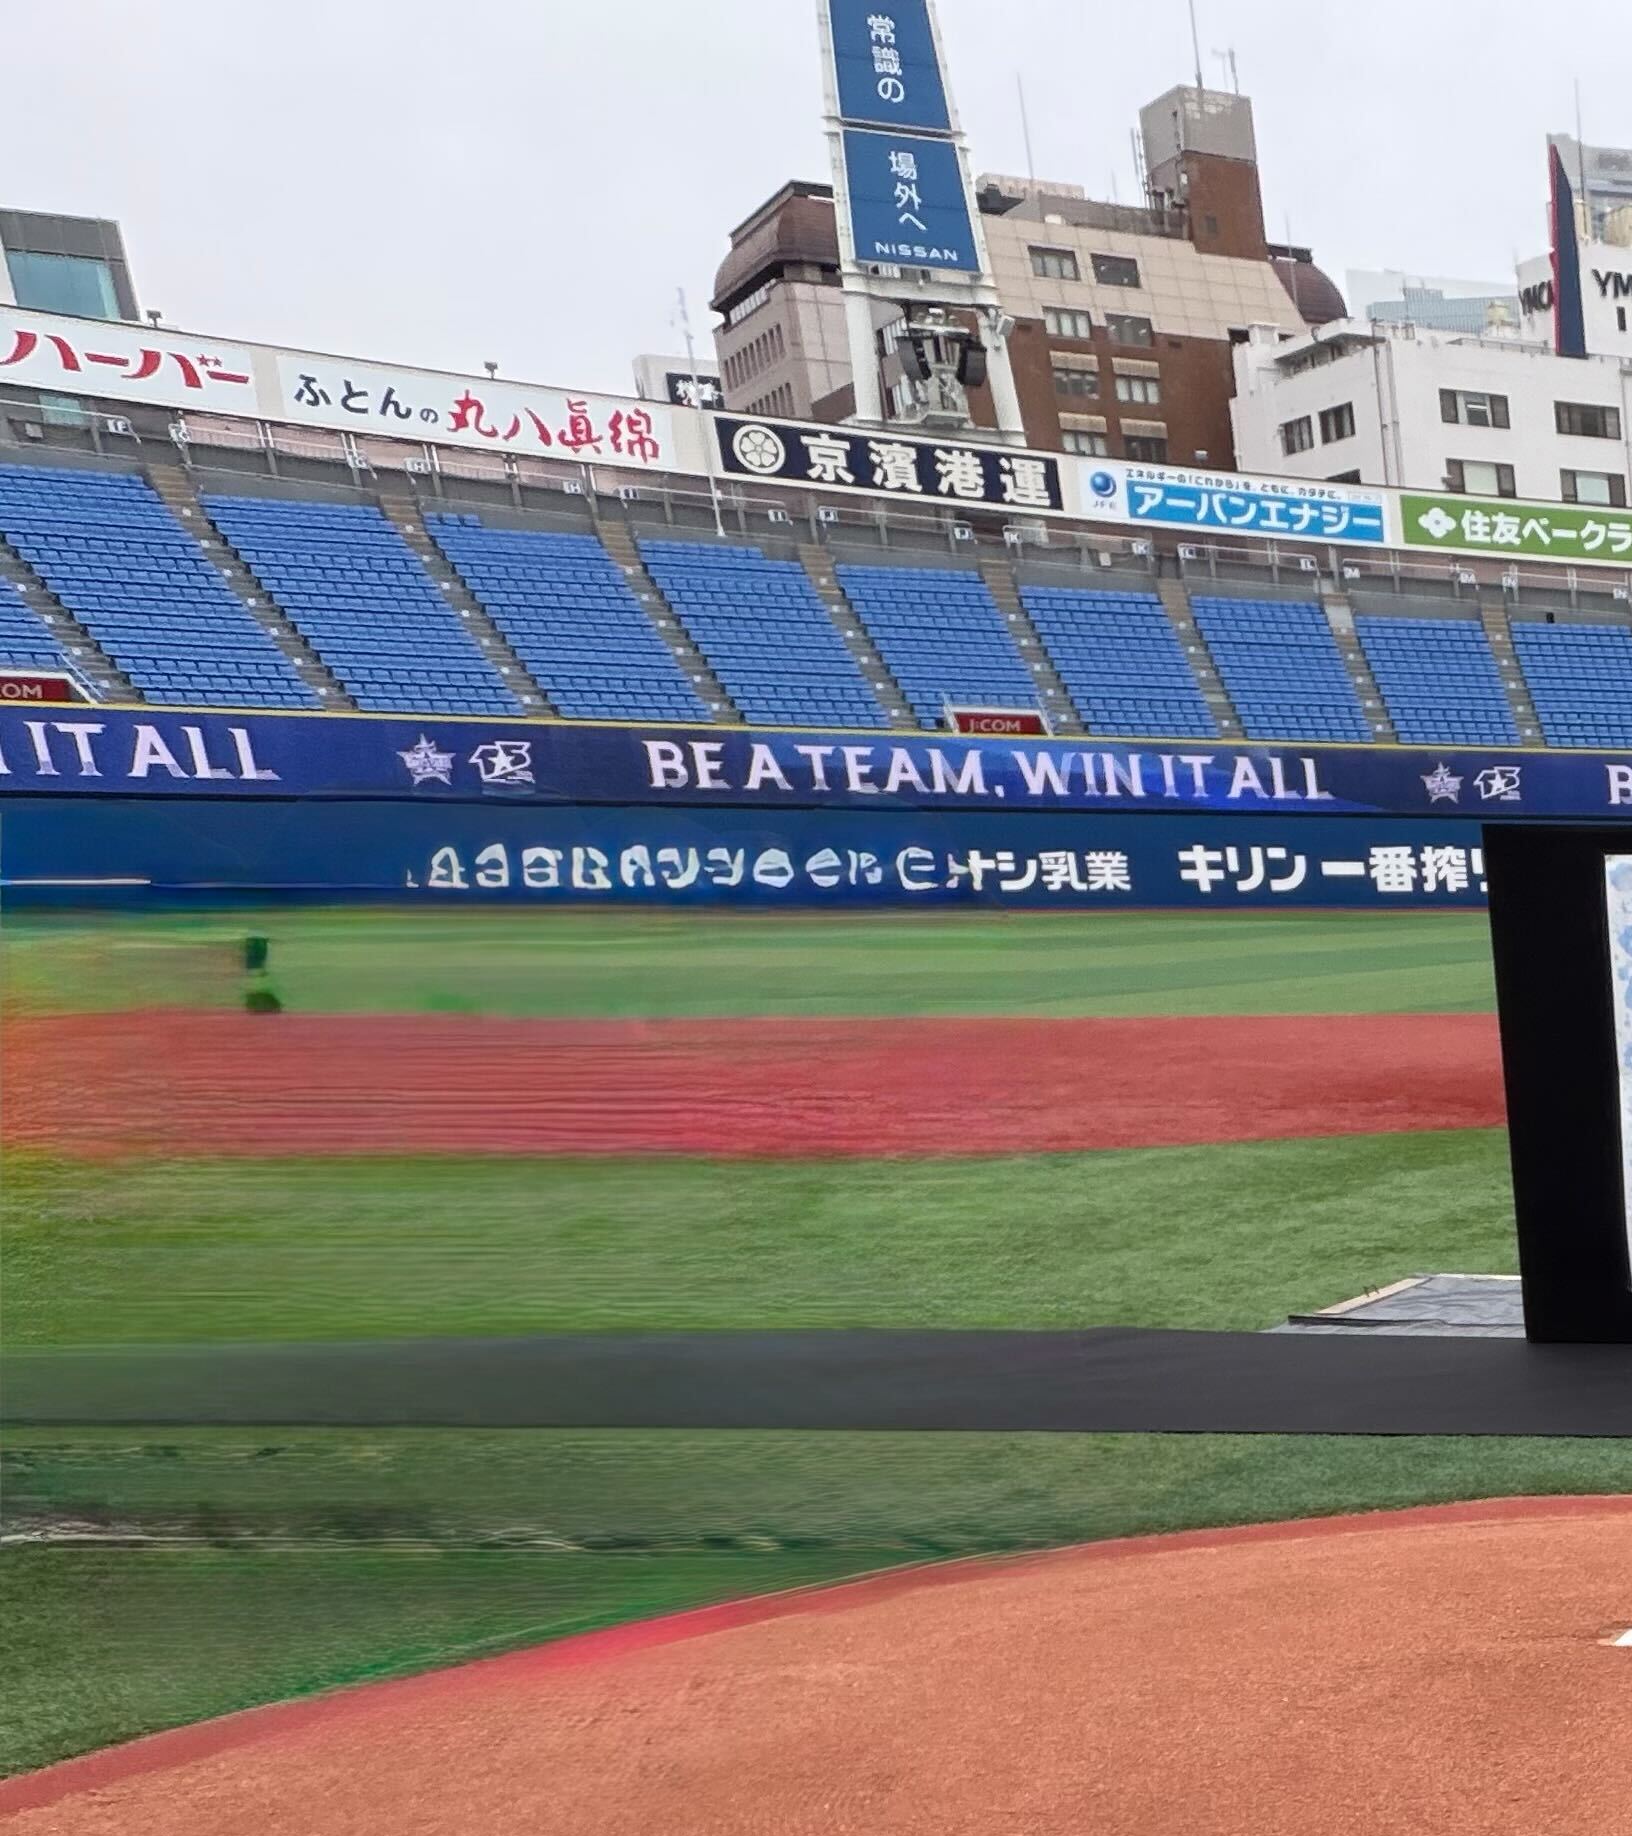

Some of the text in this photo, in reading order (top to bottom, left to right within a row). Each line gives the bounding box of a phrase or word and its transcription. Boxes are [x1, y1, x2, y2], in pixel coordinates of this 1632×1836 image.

[866, 14, 904, 104] 常識の
[888, 149, 928, 233] 場外へ
[874, 241, 958, 262] NISSAN
[0, 330, 250, 389] ハーバー
[1133, 485, 1381, 534] アーバンエナジー
[24, 722, 105, 776] IT
[128, 725, 279, 779] ALL
[642, 741, 1331, 799] BE A TEAM, WIN IT ALL
